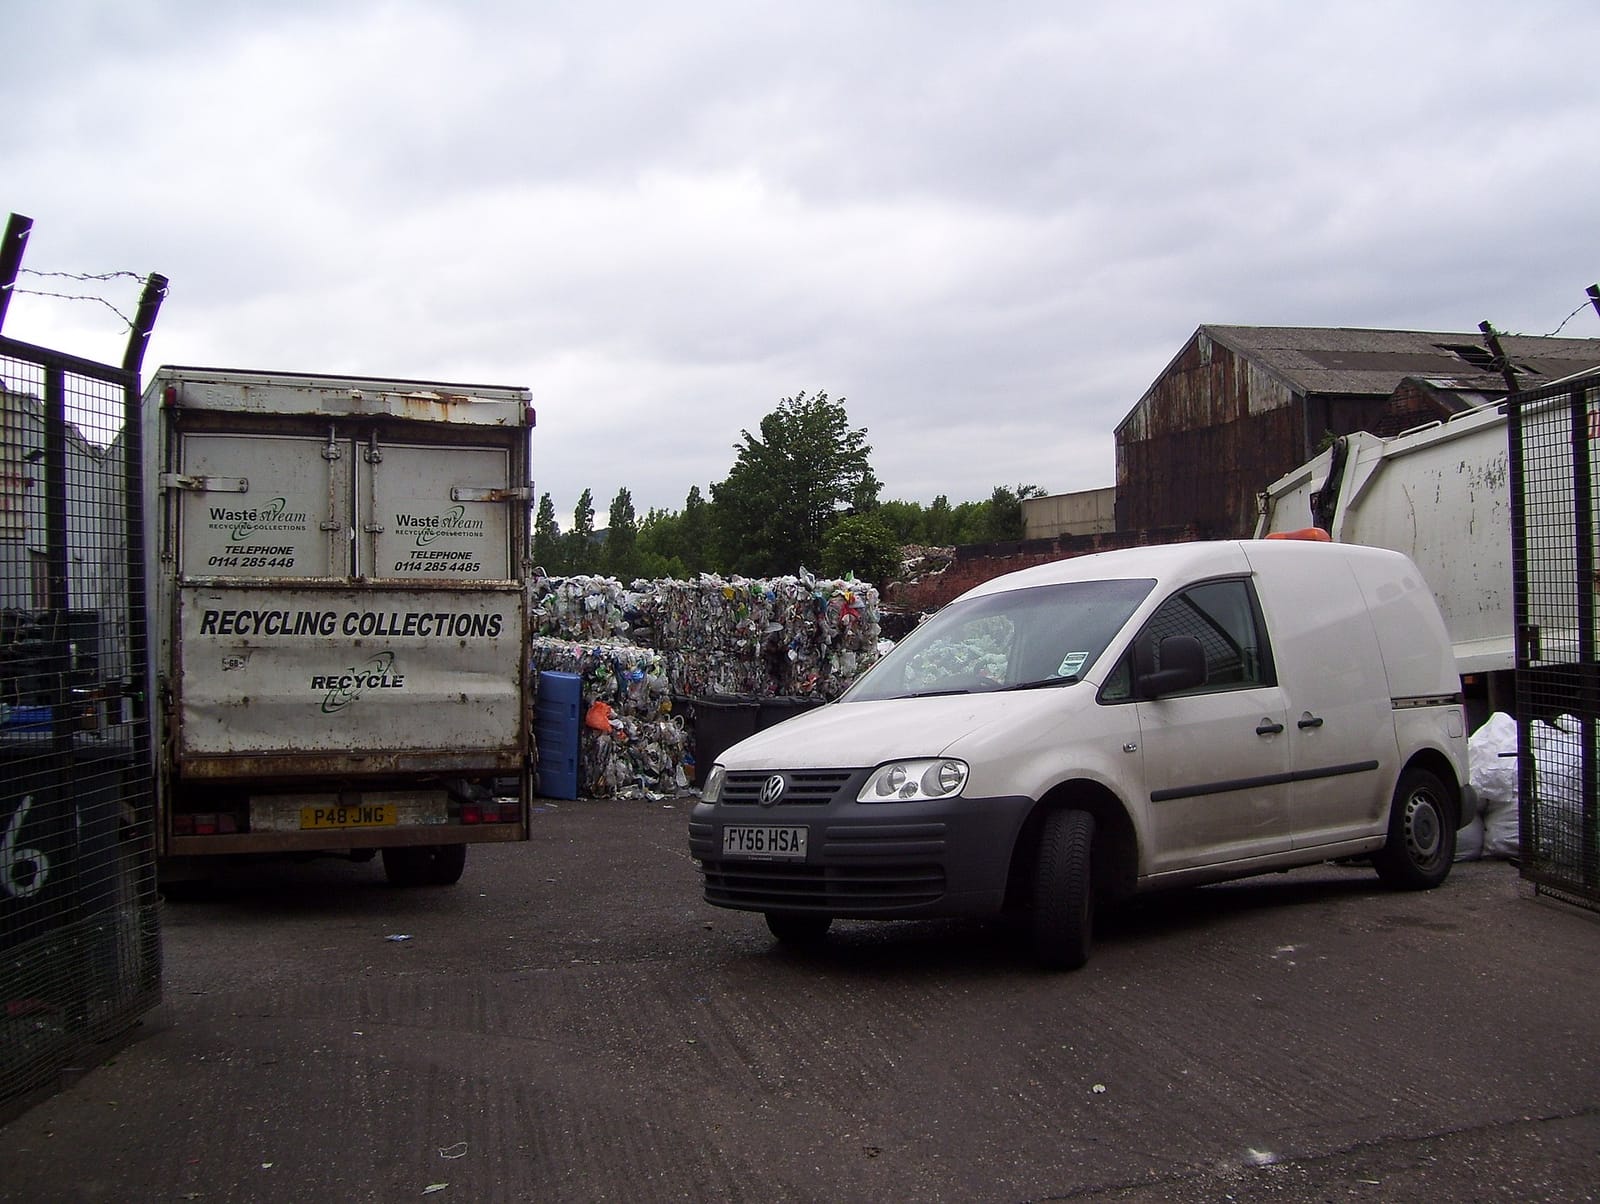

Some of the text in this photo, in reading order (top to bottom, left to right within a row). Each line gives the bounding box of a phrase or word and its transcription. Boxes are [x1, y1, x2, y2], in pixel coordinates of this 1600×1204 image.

[259, 508, 306, 522] stream
[441, 515, 483, 529] stream
[225, 545, 294, 555] TELEPHONE
[410, 550, 472, 560] TELEPHONE
[208, 556, 239, 567] 0114
[240, 557, 266, 567] 285
[394, 561, 480, 572] 0114 285 4485
[200, 610, 502, 637] RECYCLING COLLECTIONS
[311, 675, 404, 689] RECYCLE
[314, 807, 384, 825] P48 JWG
[728, 828, 799, 852] FY56 HSA
